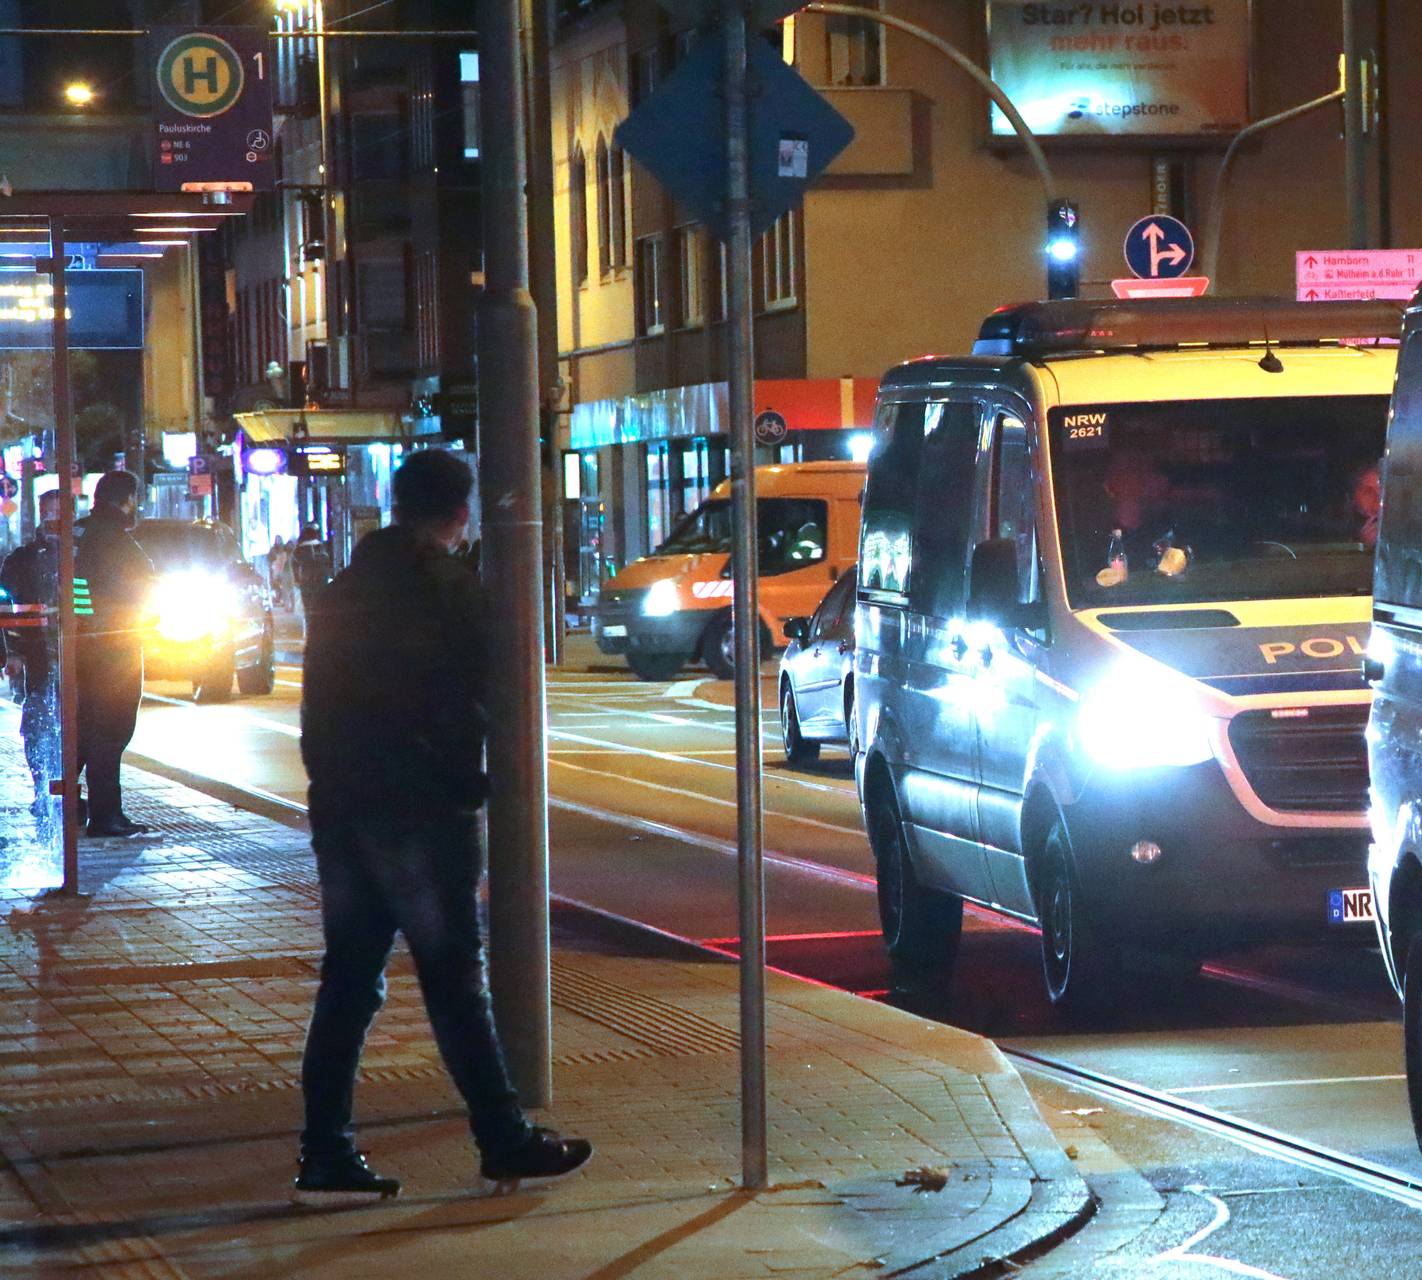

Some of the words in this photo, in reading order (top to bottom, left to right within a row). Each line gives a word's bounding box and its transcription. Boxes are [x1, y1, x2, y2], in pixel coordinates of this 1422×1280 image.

[1023, 4, 1092, 24] Star?
[1101, 2, 1144, 24] Hol
[1150, 4, 1215, 31] jetzt
[1125, 34, 1187, 50] raus.
[253, 52, 263, 79] 1
[1095, 101, 1180, 119] stepstone
[159, 123, 212, 133] Pauluskirche
[1323, 256, 1369, 265] Hamborn
[1064, 413, 1106, 428] NRW
[1070, 426, 1102, 438] 2621
